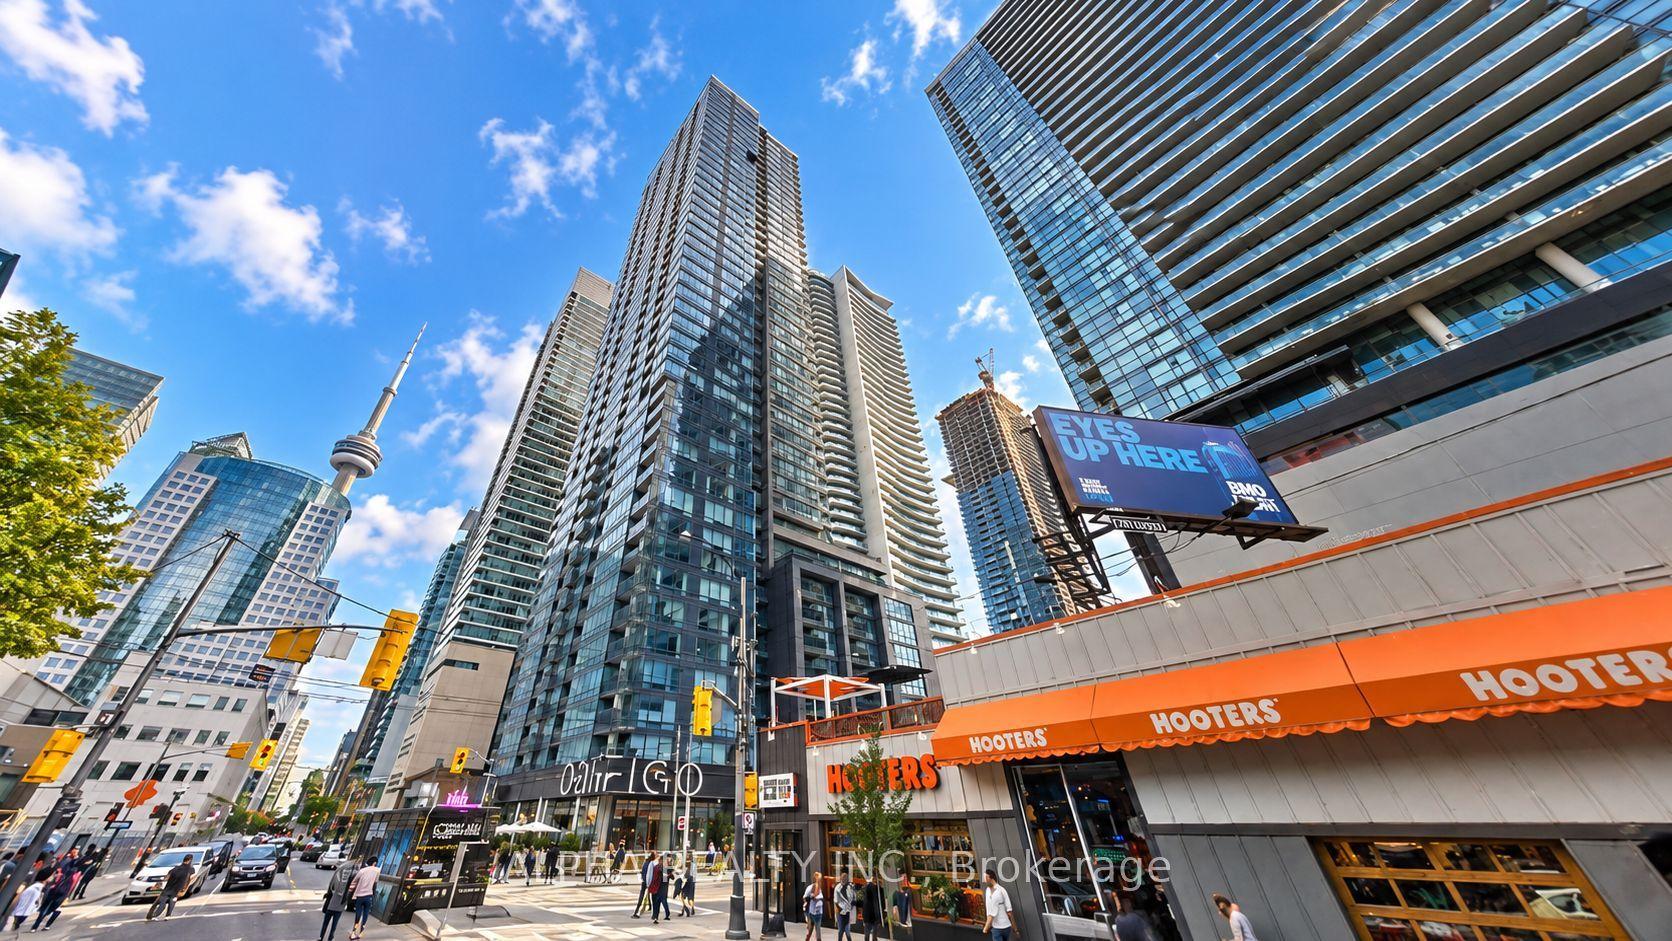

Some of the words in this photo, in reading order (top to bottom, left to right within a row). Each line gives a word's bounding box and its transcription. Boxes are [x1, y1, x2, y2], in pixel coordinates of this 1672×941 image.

[1050, 413, 1141, 444] EYES
[1058, 435, 1110, 463] UP
[1112, 441, 1209, 475] HERE
[1226, 480, 1267, 498] BMO
[1459, 646, 1672, 702] HOOTER
[1149, 698, 1281, 734] HOOTERS
[968, 728, 1047, 754] HOOTERS
